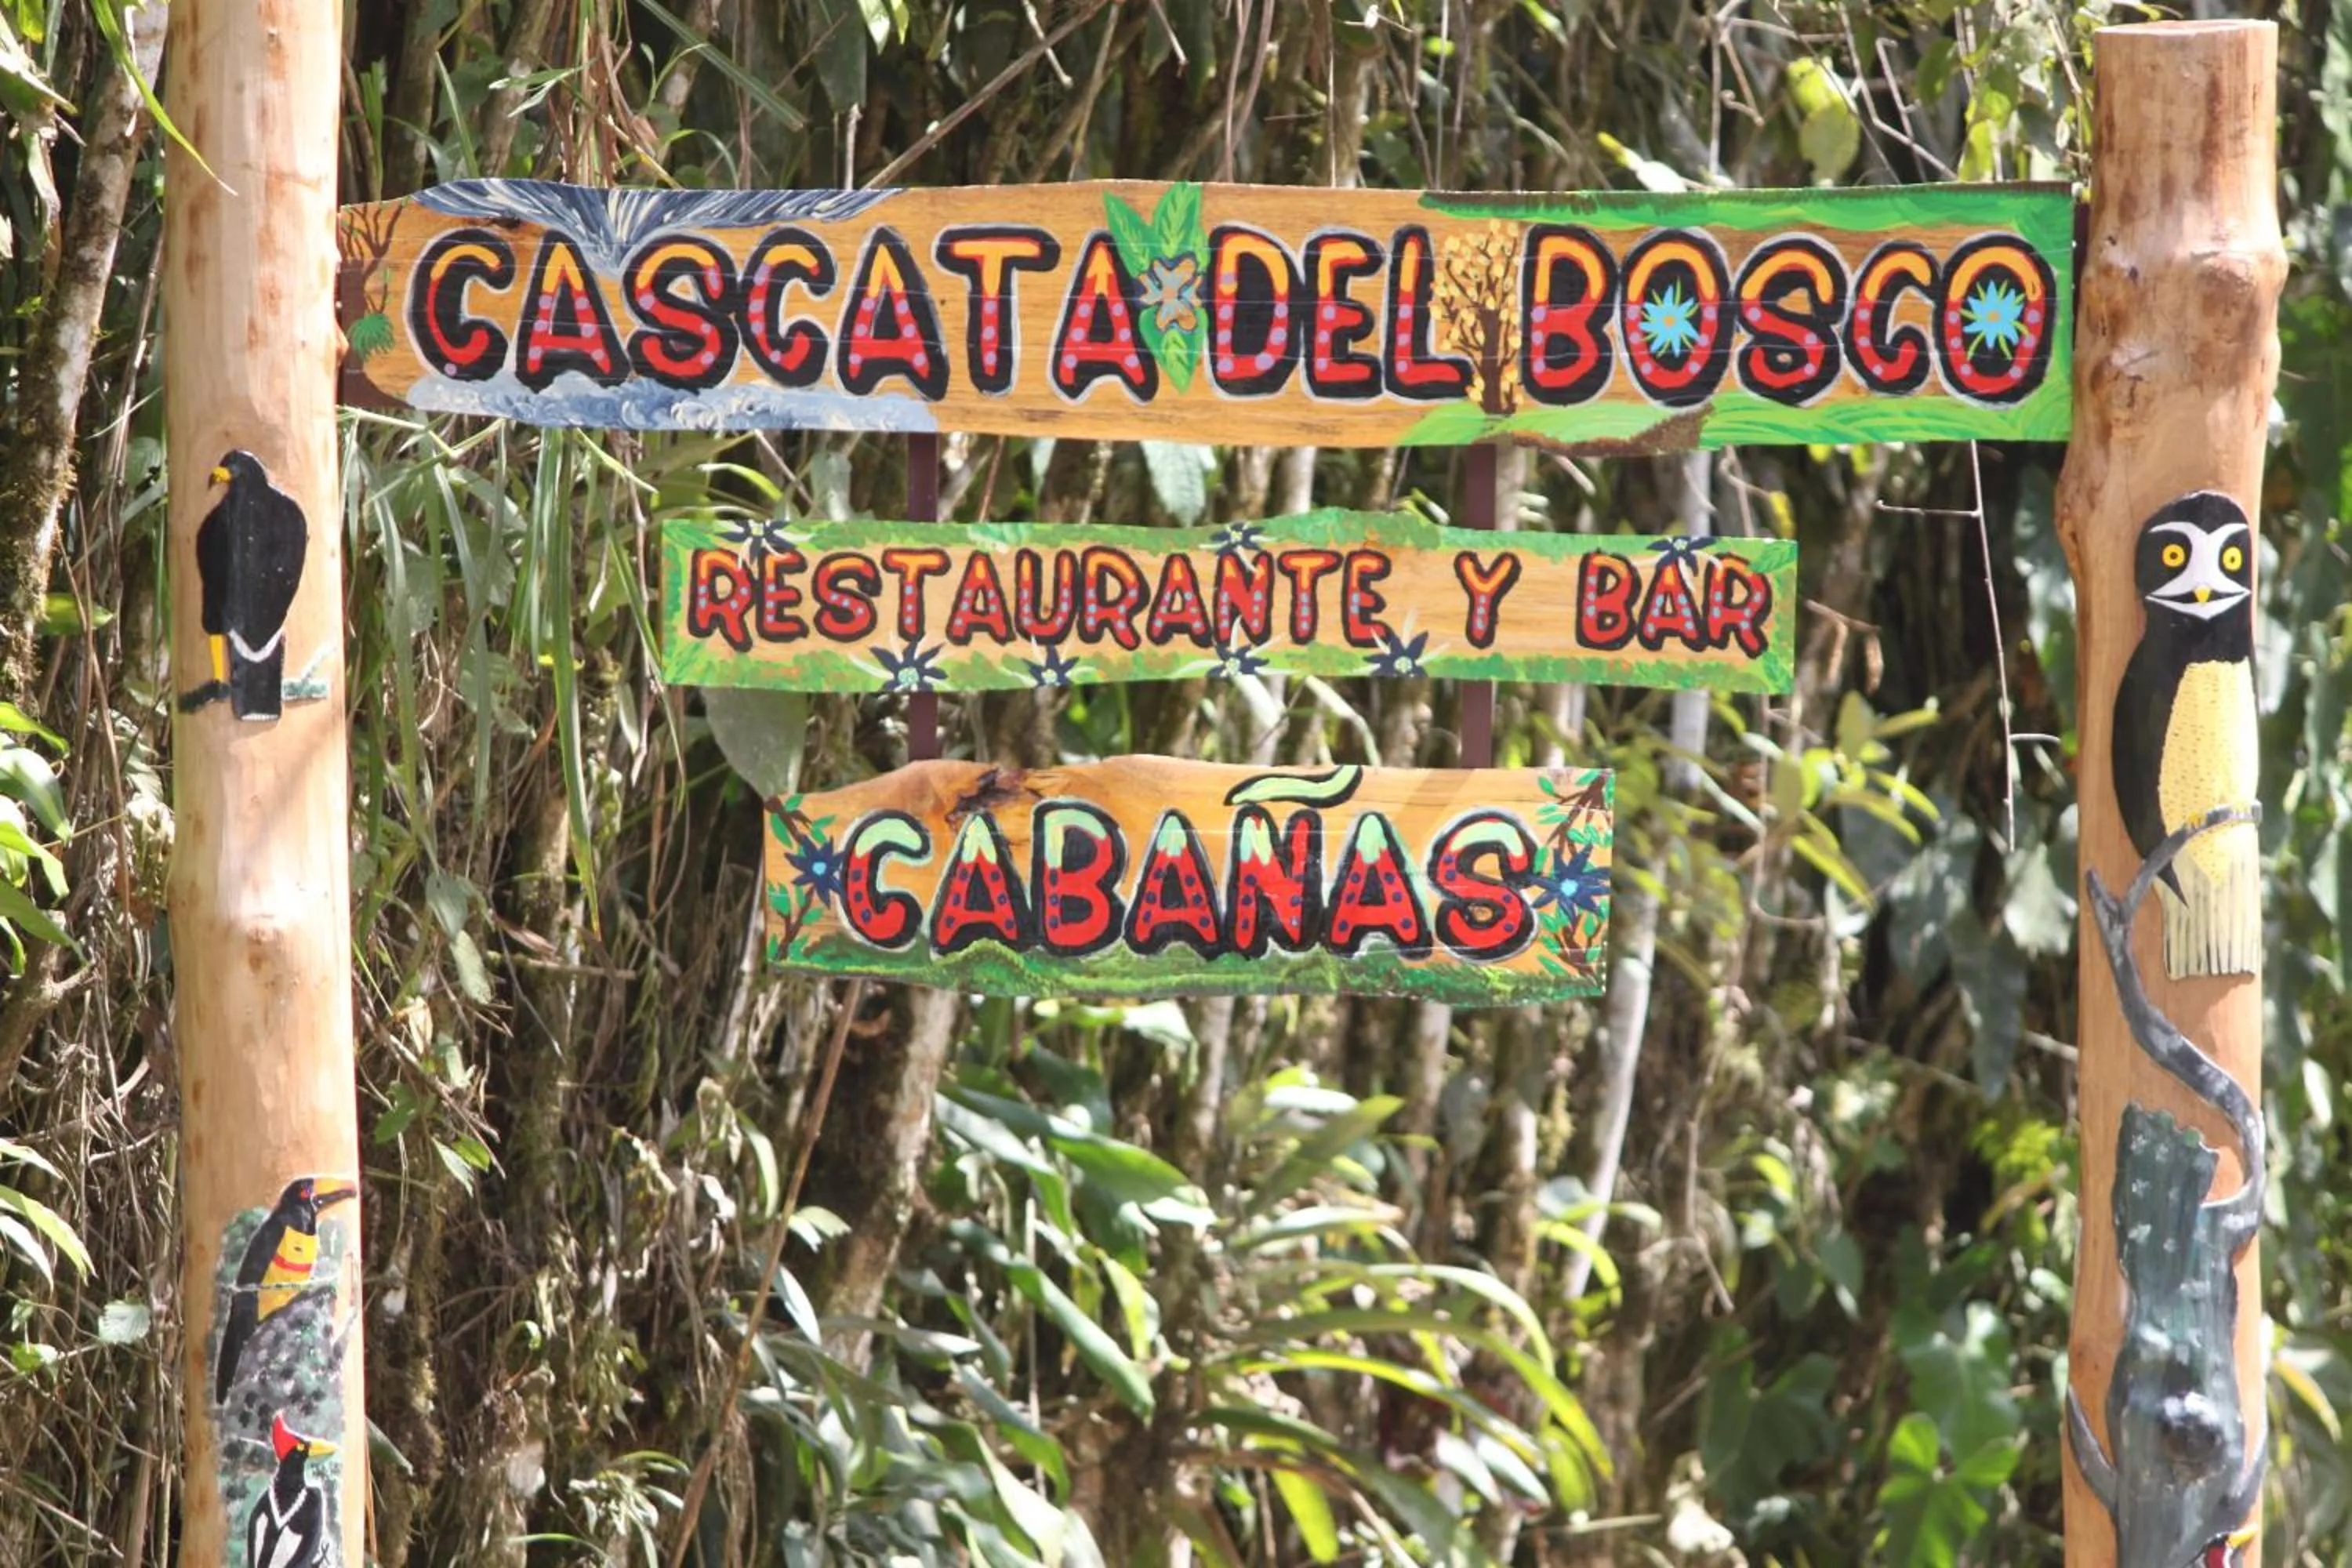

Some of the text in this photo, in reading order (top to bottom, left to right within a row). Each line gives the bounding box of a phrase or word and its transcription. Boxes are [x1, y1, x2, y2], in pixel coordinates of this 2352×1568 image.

[406, 223, 2057, 409] CASCATA DEL BOSCO
[689, 548, 1777, 655] RESTAURANTE Y BAR
[837, 764, 1540, 963] CABAÑAS
